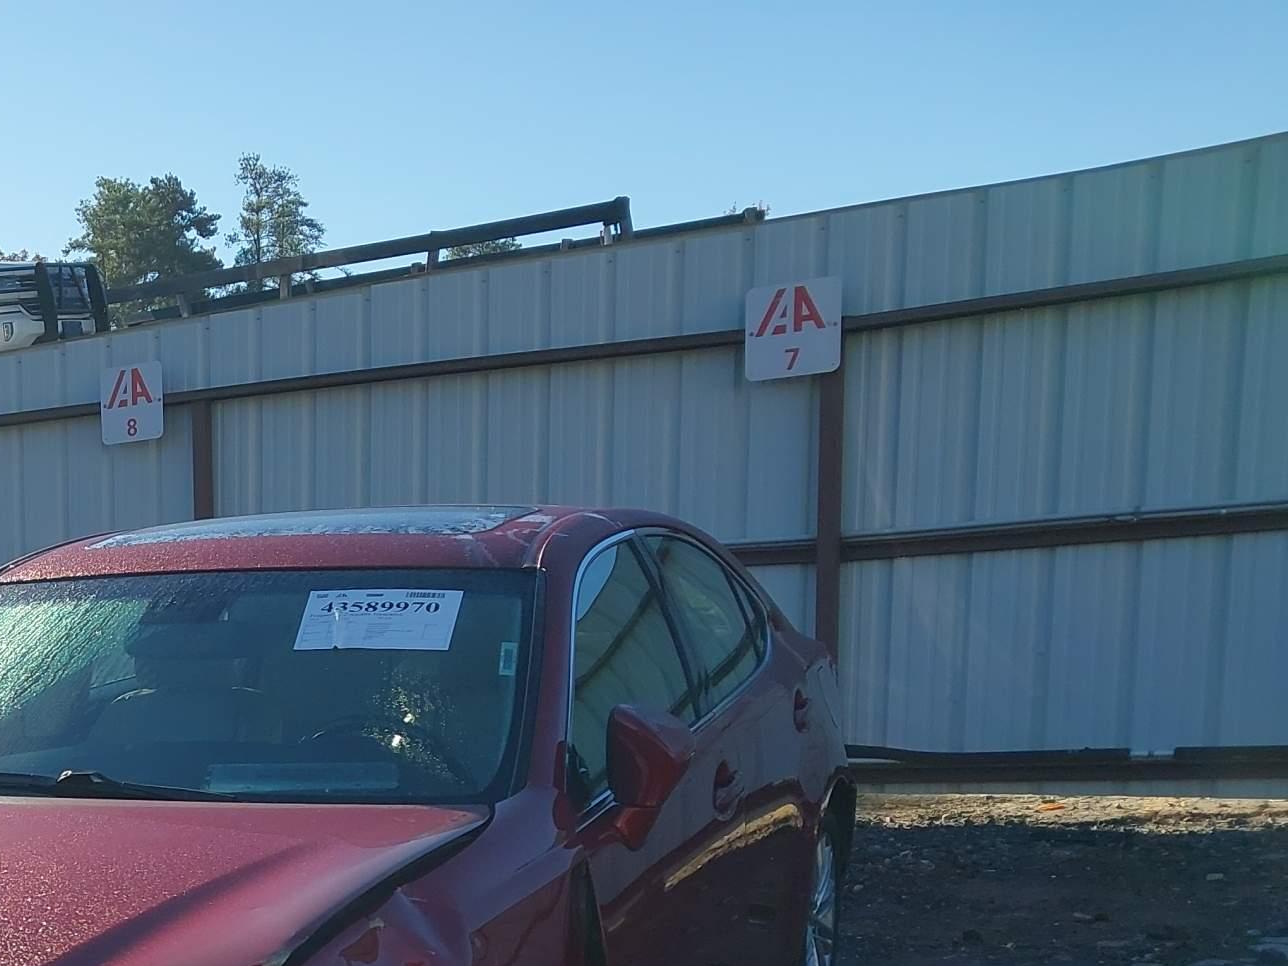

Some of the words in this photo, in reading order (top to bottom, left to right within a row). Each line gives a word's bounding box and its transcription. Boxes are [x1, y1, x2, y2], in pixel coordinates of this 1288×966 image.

[784, 348, 800, 370] 7
[127, 418, 137, 436] 8
[320, 601, 440, 613] 43589970
